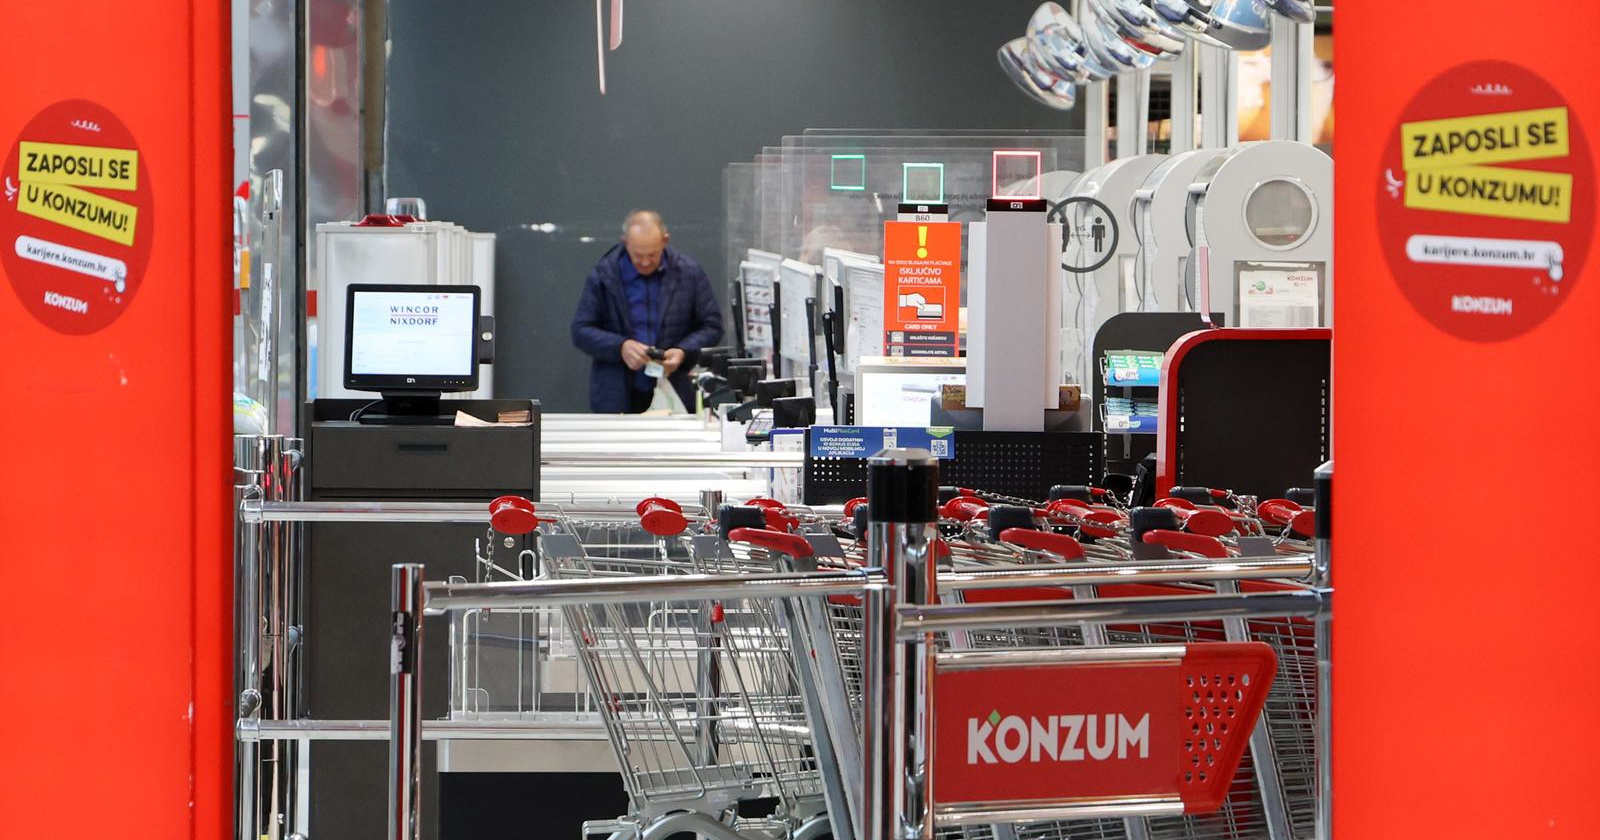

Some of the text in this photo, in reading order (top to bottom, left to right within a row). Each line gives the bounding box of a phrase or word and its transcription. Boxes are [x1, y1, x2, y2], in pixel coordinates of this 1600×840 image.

[1413, 121, 1558, 157] ZAPOSLI SE
[26, 152, 131, 180] ZAPOSLI SE
[1417, 173, 1561, 207] U KONZUMU!
[27, 184, 128, 232] U KONZUMU!
[915, 214, 930, 222] B60
[26, 243, 107, 274] karijere.konzum.hr
[1423, 244, 1536, 261] karijere.konzum.hr
[898, 276, 942, 285] KARTICAMA
[43, 290, 89, 315] KONZUM
[390, 306, 439, 314] WINCOR
[1451, 295, 1513, 315] KONZUM
[390, 318, 438, 326] NIXDORF
[967, 711, 1150, 764] KONZUM
